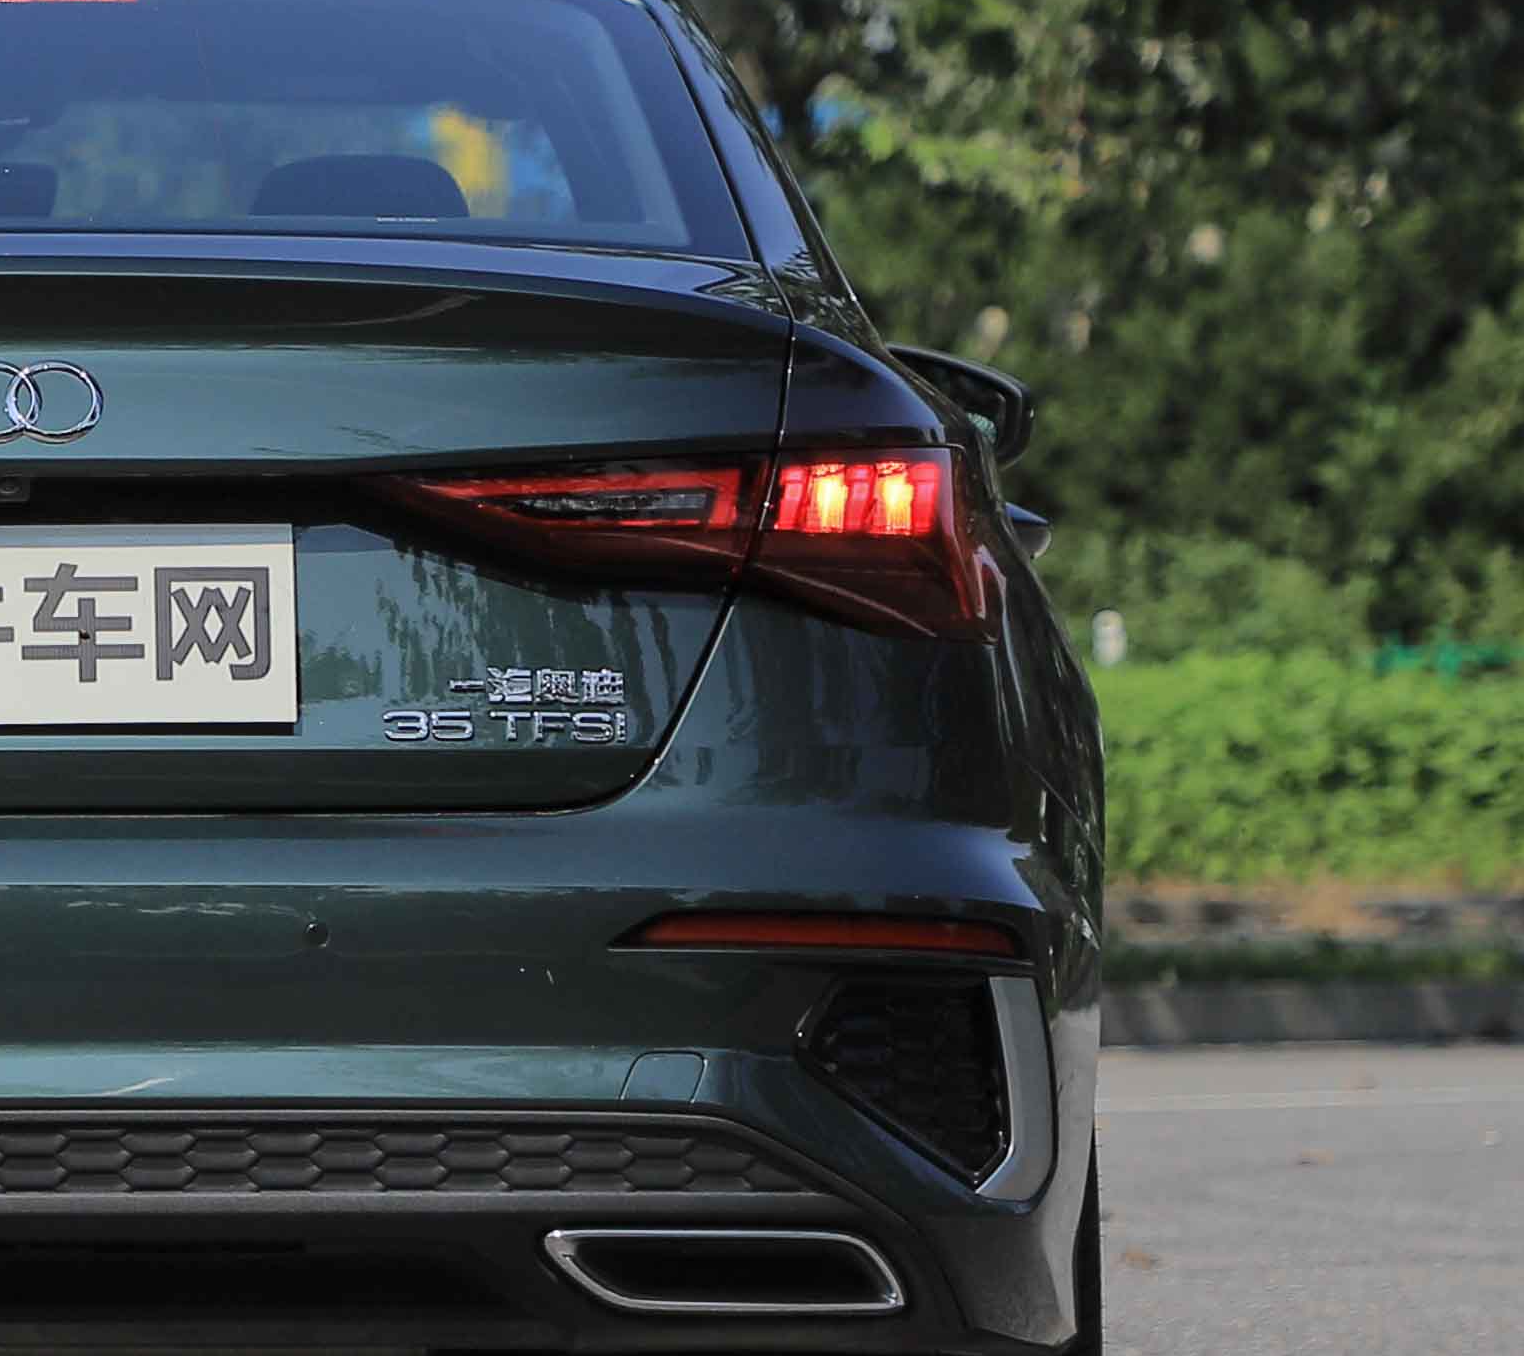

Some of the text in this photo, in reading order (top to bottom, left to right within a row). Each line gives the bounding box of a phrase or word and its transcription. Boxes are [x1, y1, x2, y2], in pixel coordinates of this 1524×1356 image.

[449, 666, 625, 704] 一汽奥迪
[382, 710, 626, 741] 35 TFSI
